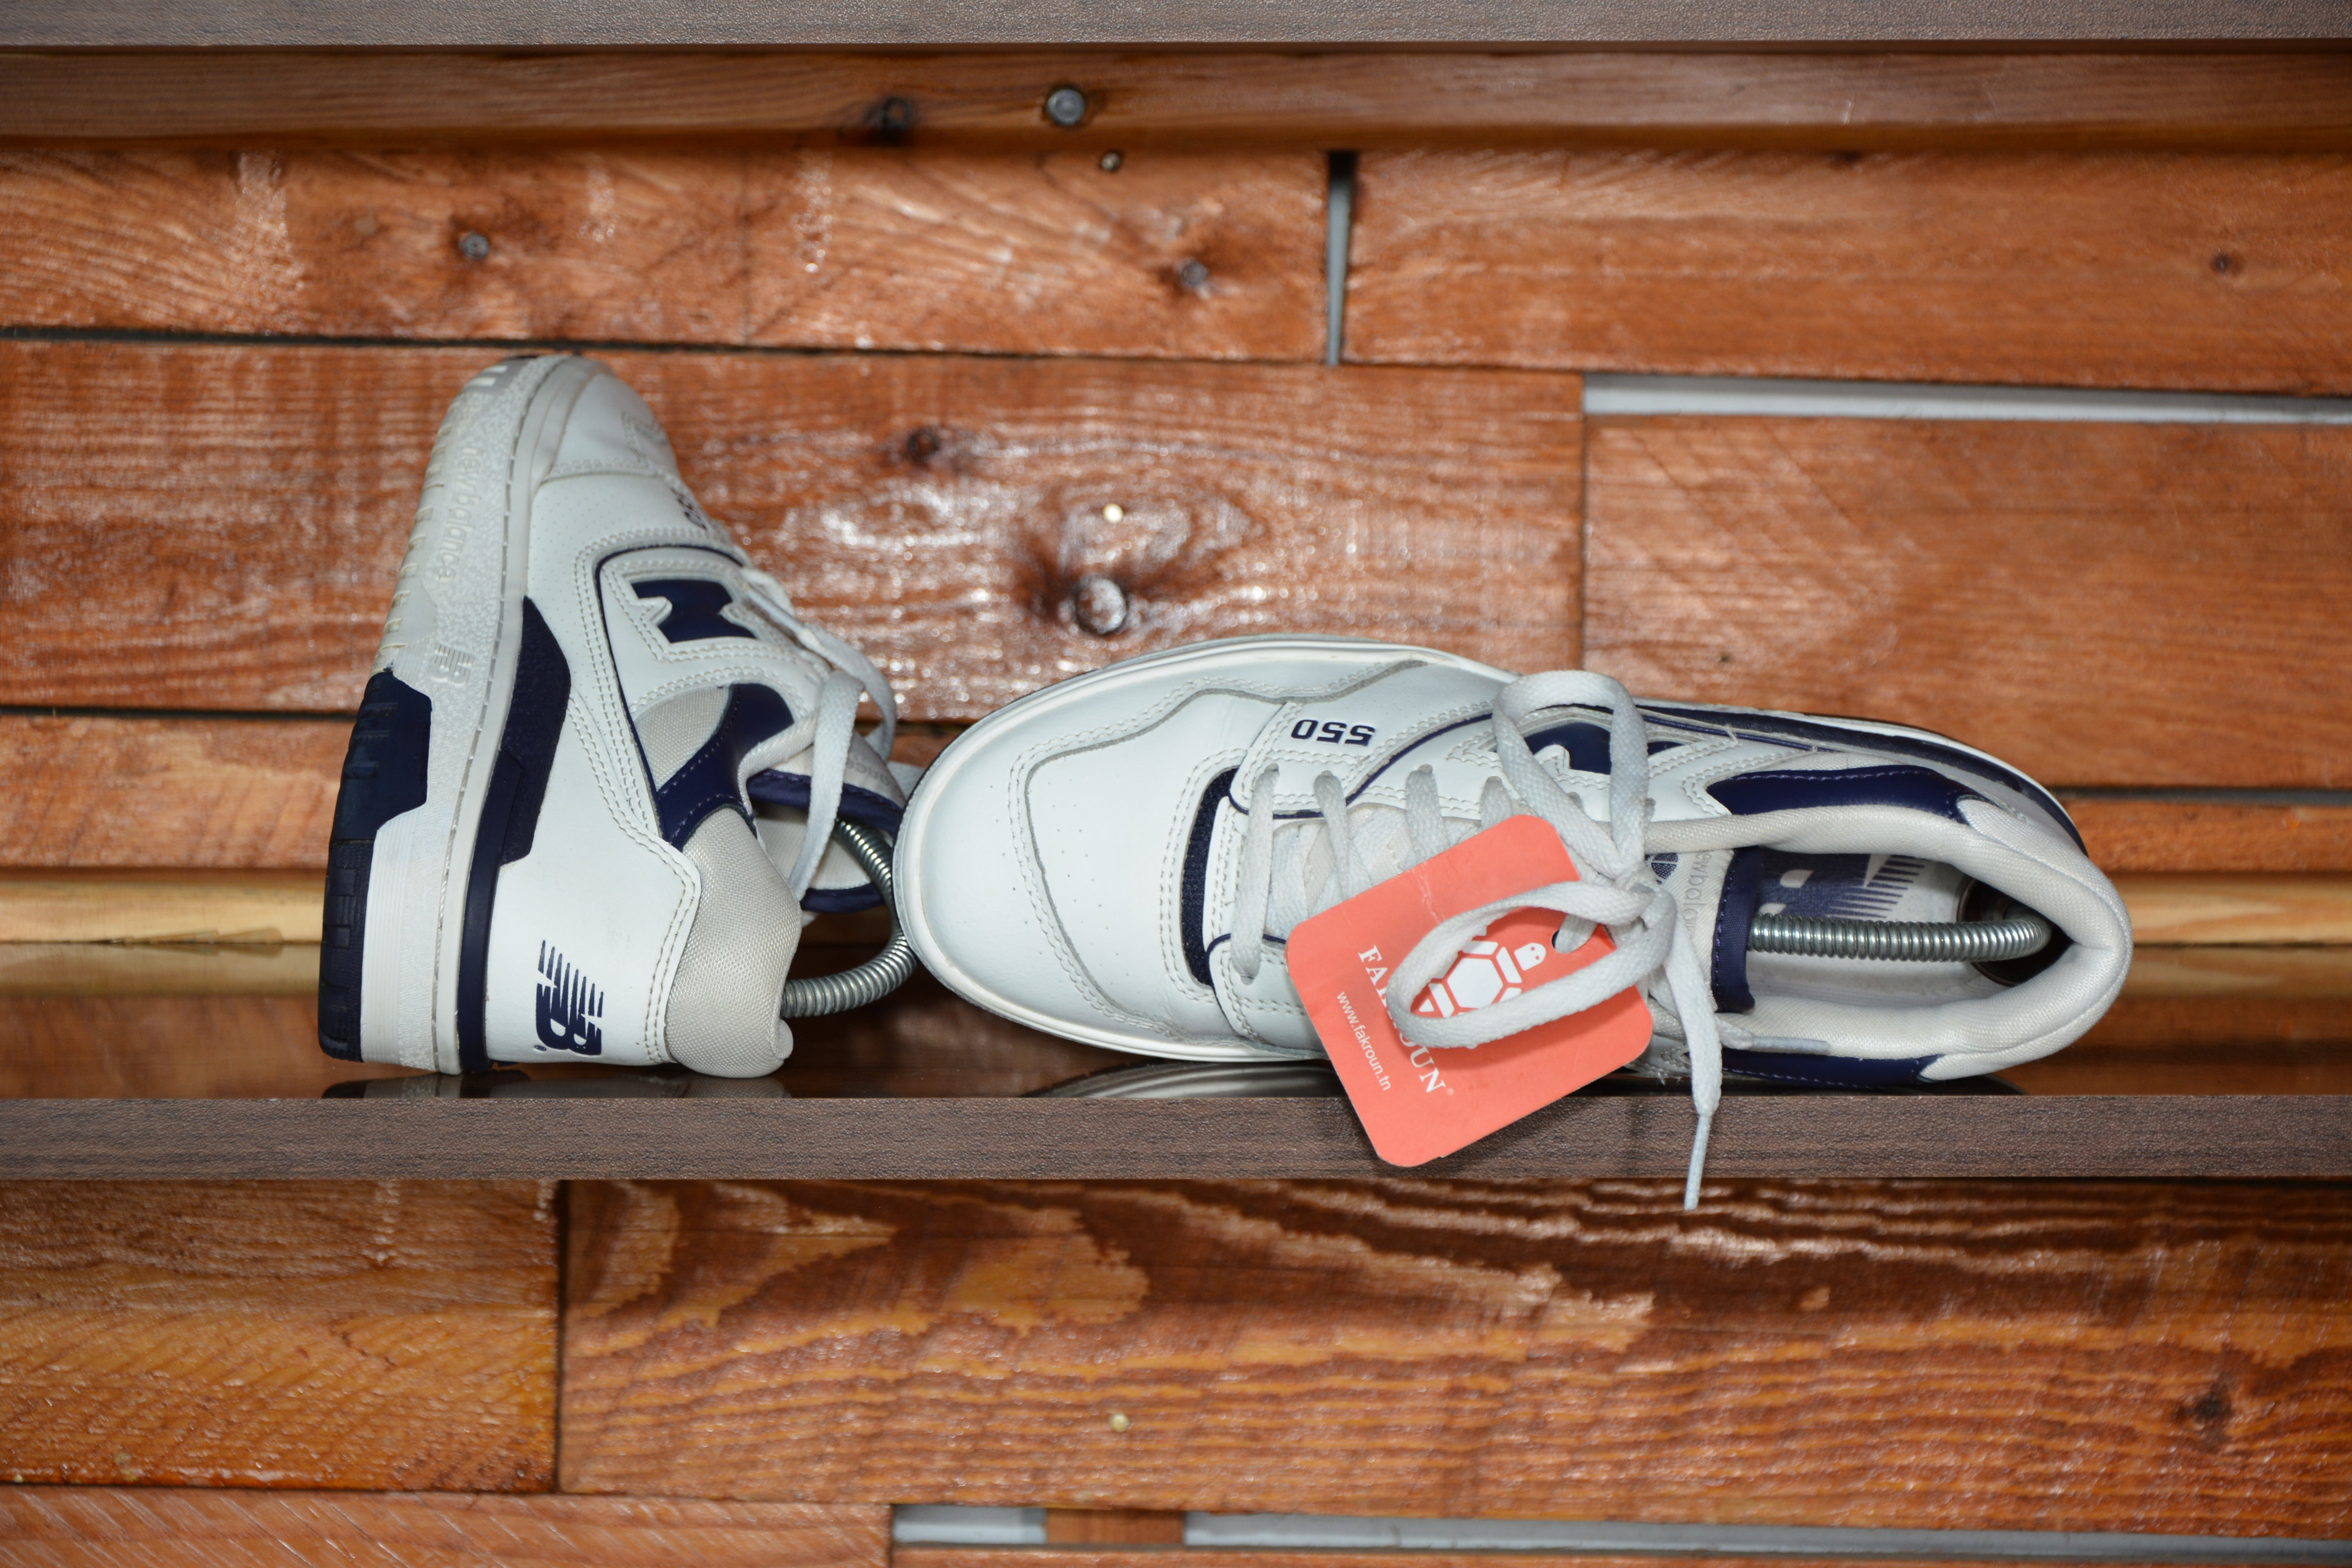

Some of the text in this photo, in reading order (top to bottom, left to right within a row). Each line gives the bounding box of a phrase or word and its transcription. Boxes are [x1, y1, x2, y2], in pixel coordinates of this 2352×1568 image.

[1291, 719, 1376, 746] 550
[1337, 991, 1391, 1091] www.fakroun.tn
[1358, 945, 1446, 1093] FAUN
